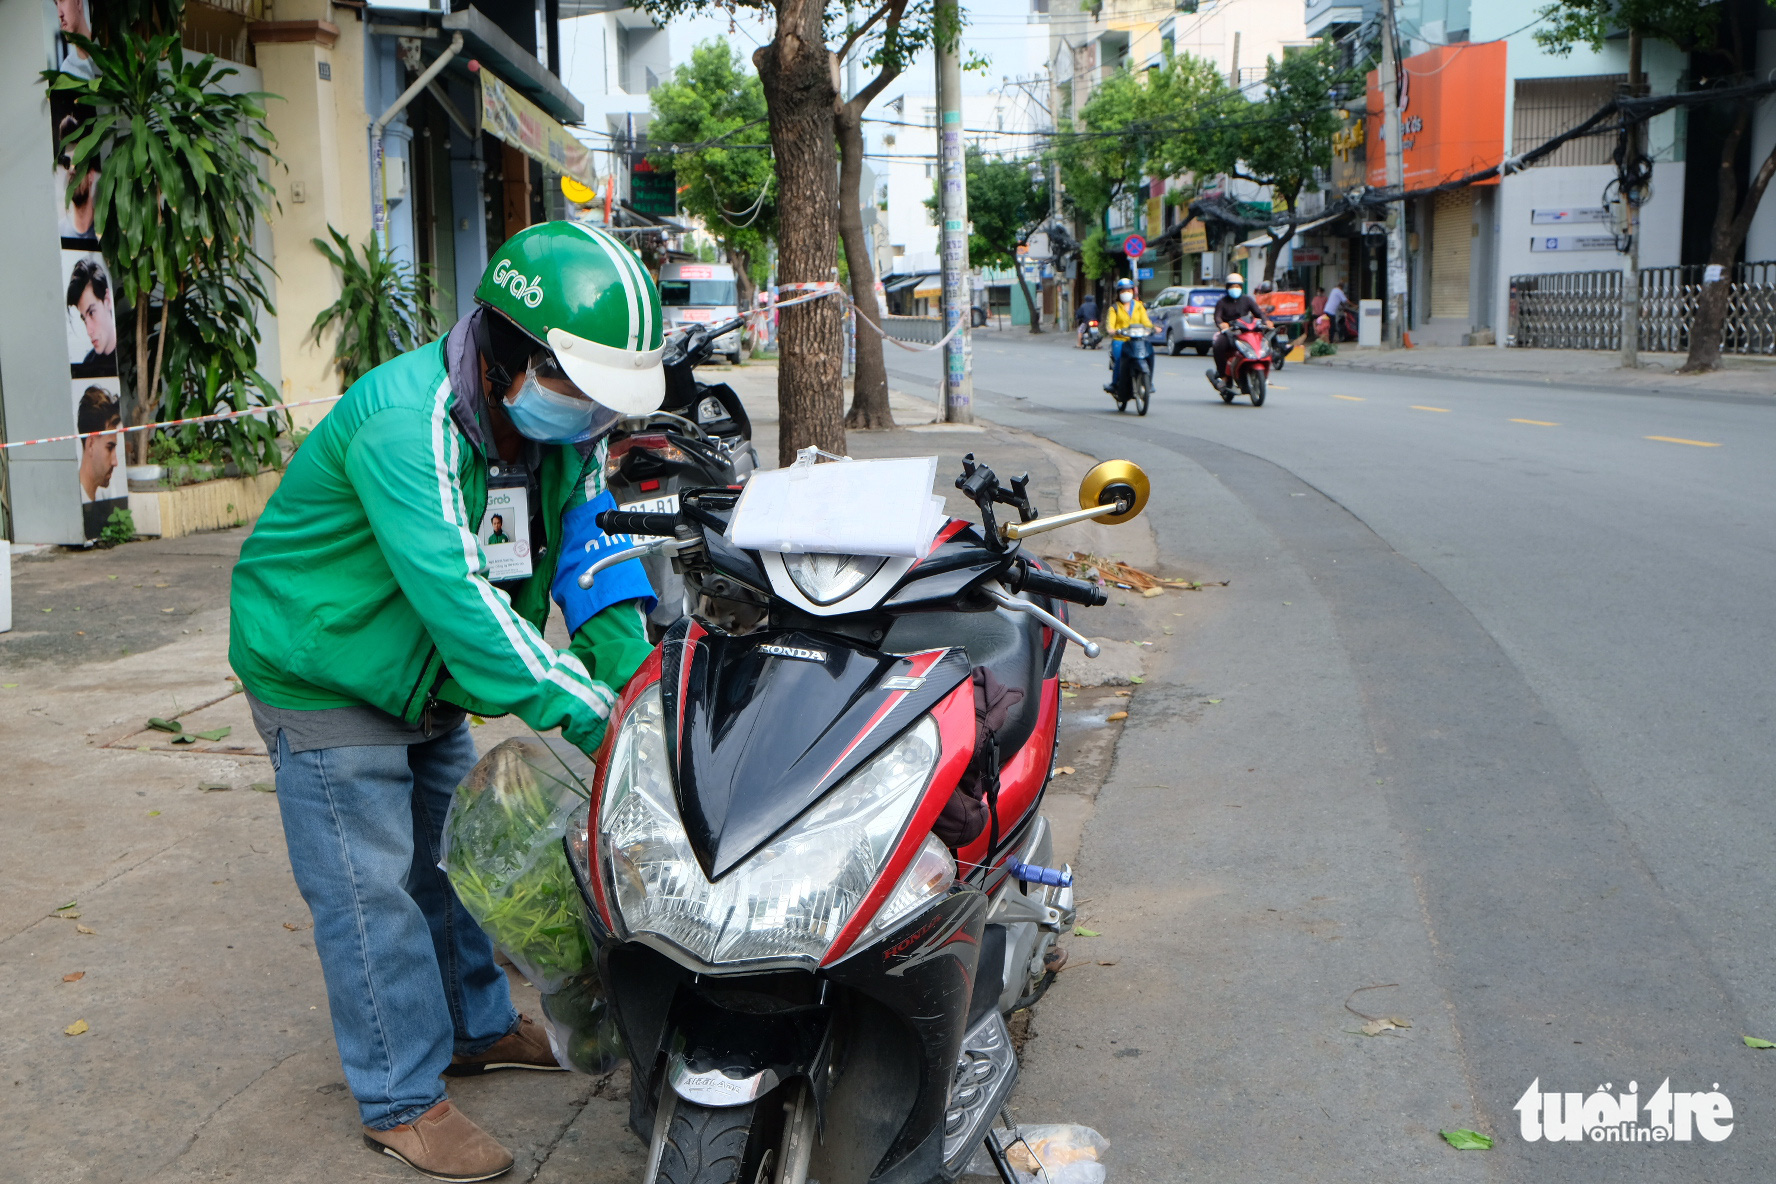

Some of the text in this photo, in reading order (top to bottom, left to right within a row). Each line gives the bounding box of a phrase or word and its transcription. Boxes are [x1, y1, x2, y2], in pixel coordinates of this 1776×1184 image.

[492, 258, 544, 309] Grab
[487, 493, 511, 506] Grab
[759, 644, 826, 662] HONDA
